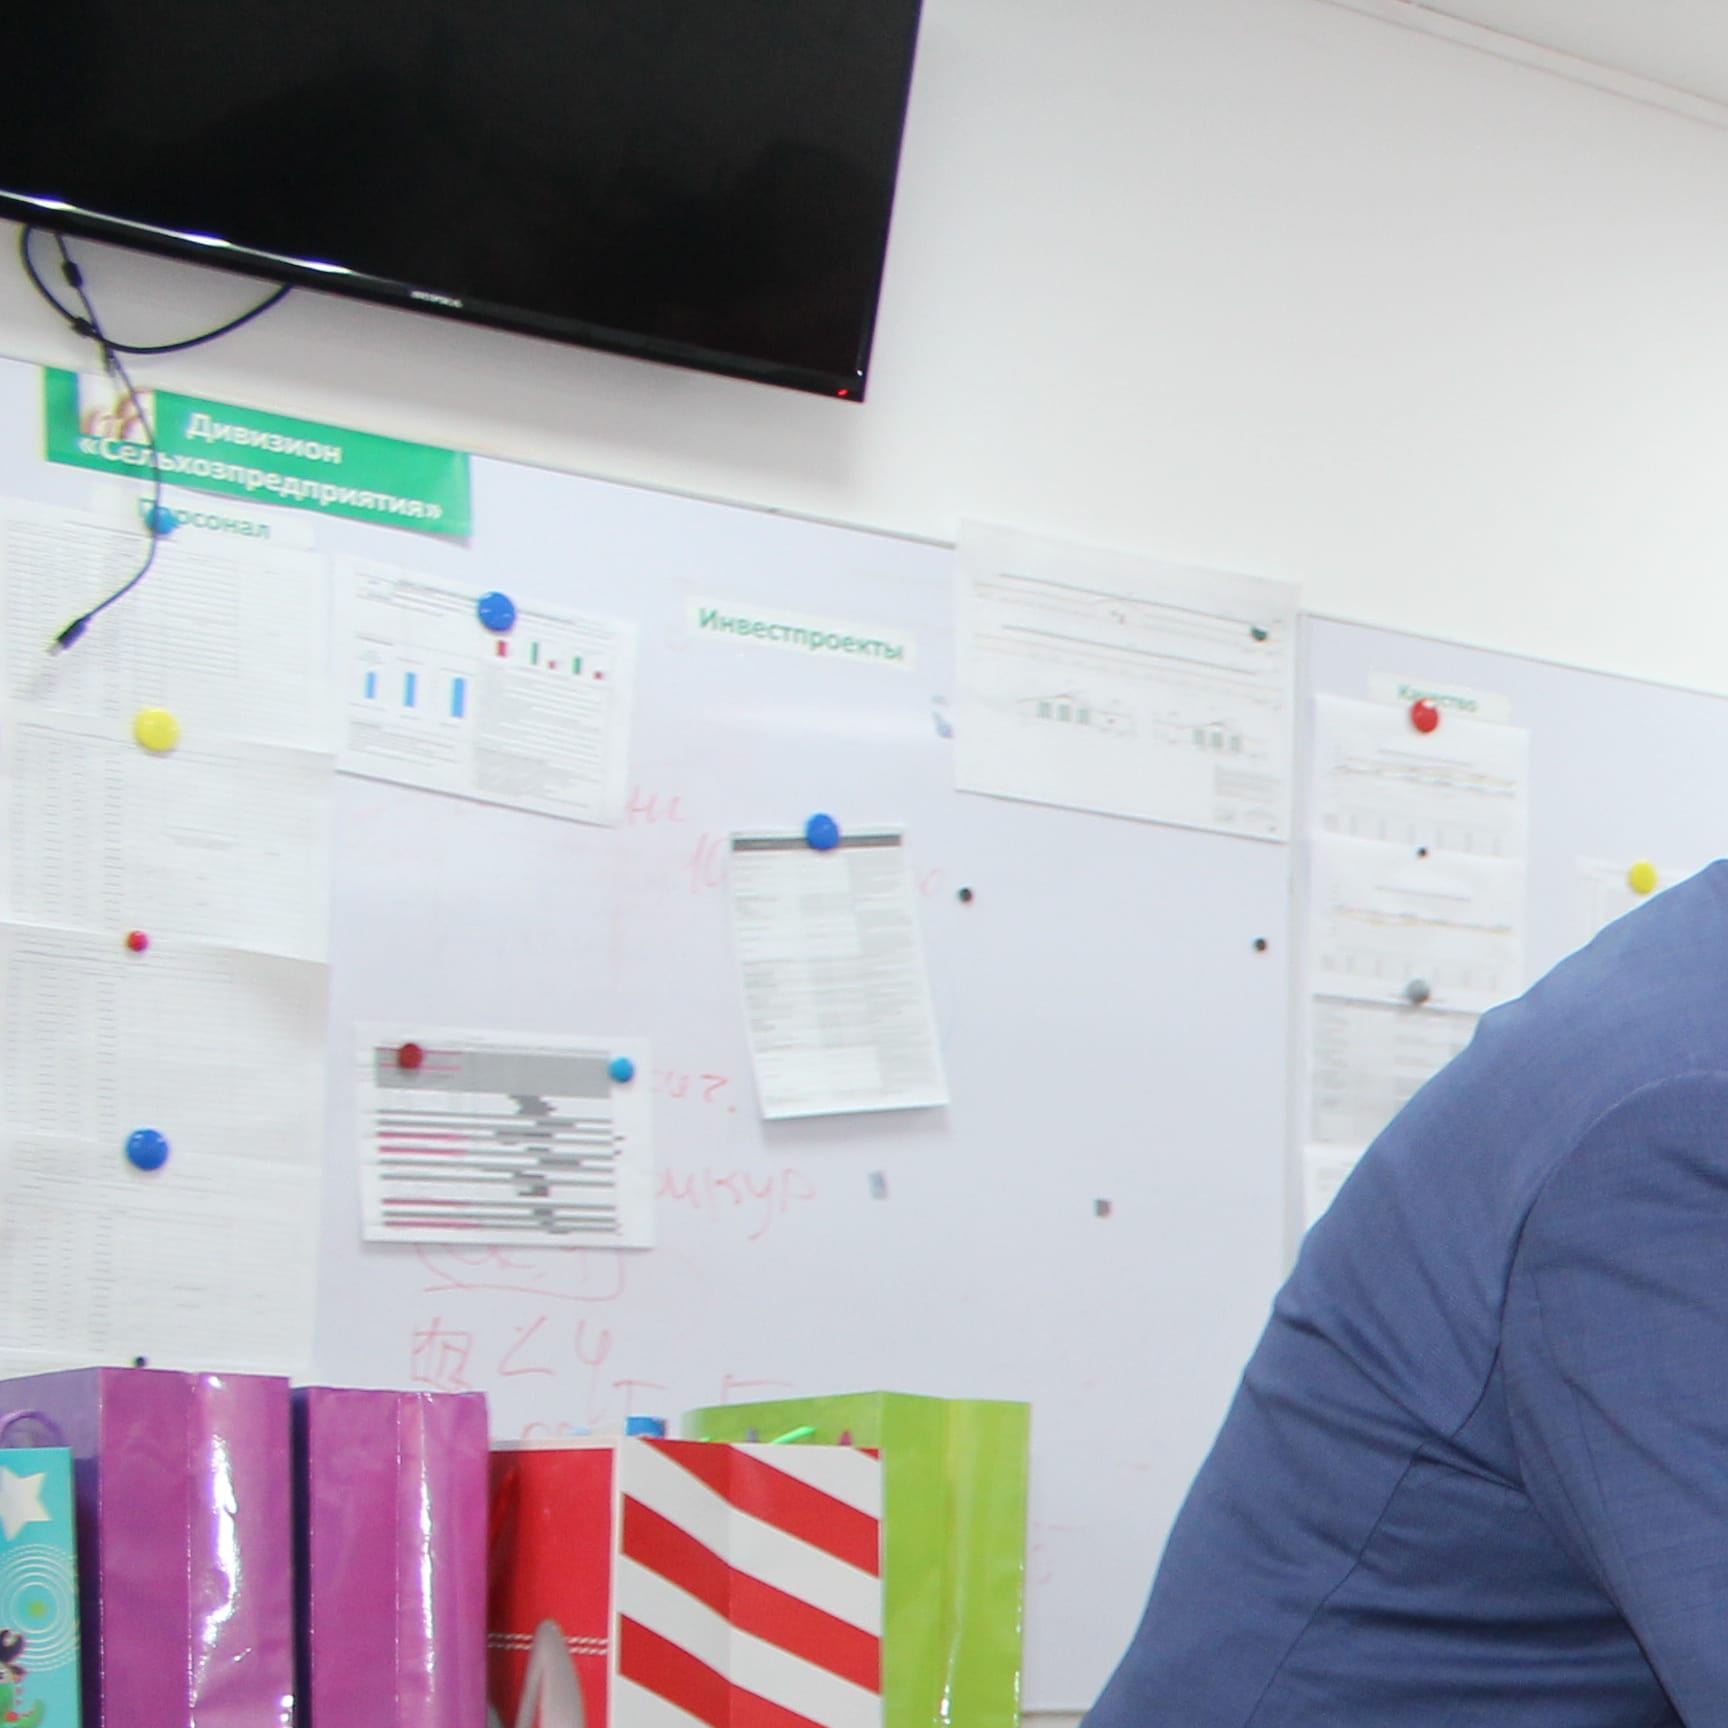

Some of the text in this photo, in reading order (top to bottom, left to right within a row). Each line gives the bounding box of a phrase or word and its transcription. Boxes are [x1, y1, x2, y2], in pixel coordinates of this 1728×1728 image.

[185, 412, 342, 465] Дивизион
[78, 436, 443, 521] «Сельхозпредприятия»
[699, 607, 904, 660] Инвестпроекты
